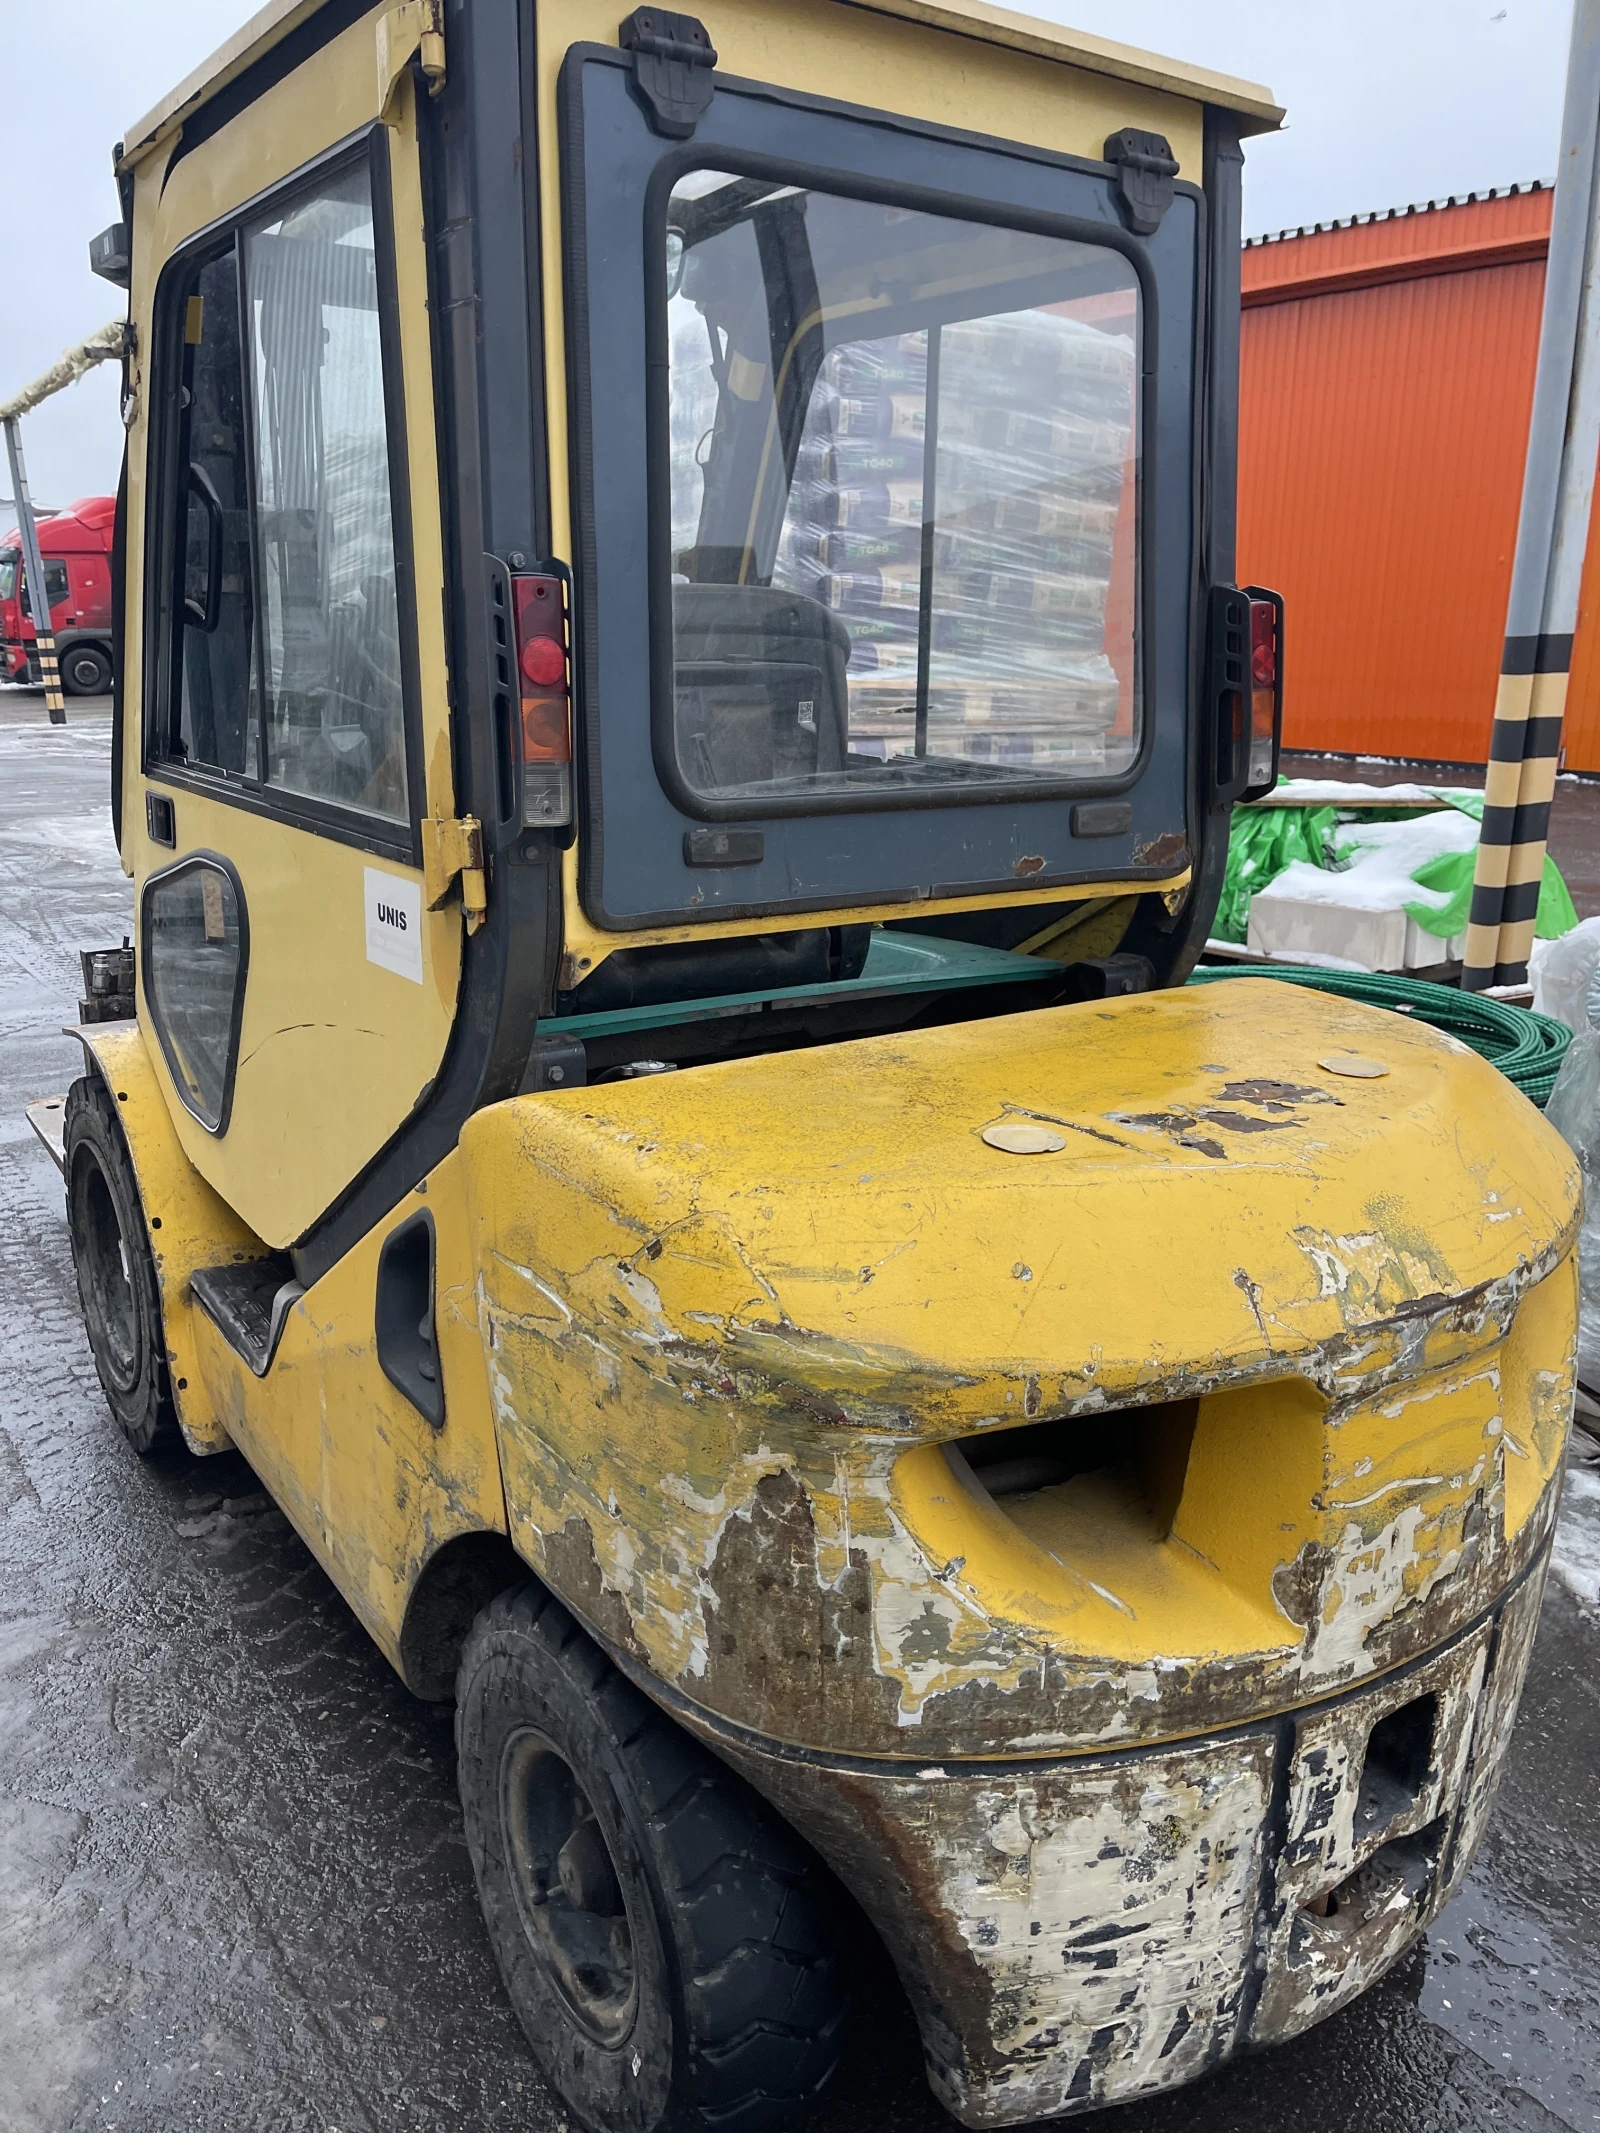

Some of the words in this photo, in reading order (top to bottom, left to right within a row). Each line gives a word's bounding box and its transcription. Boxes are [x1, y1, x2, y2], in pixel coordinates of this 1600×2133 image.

[862, 458, 894, 468] TG40
[855, 625, 884, 635] TG40
[377, 903, 407, 931] UNIS
